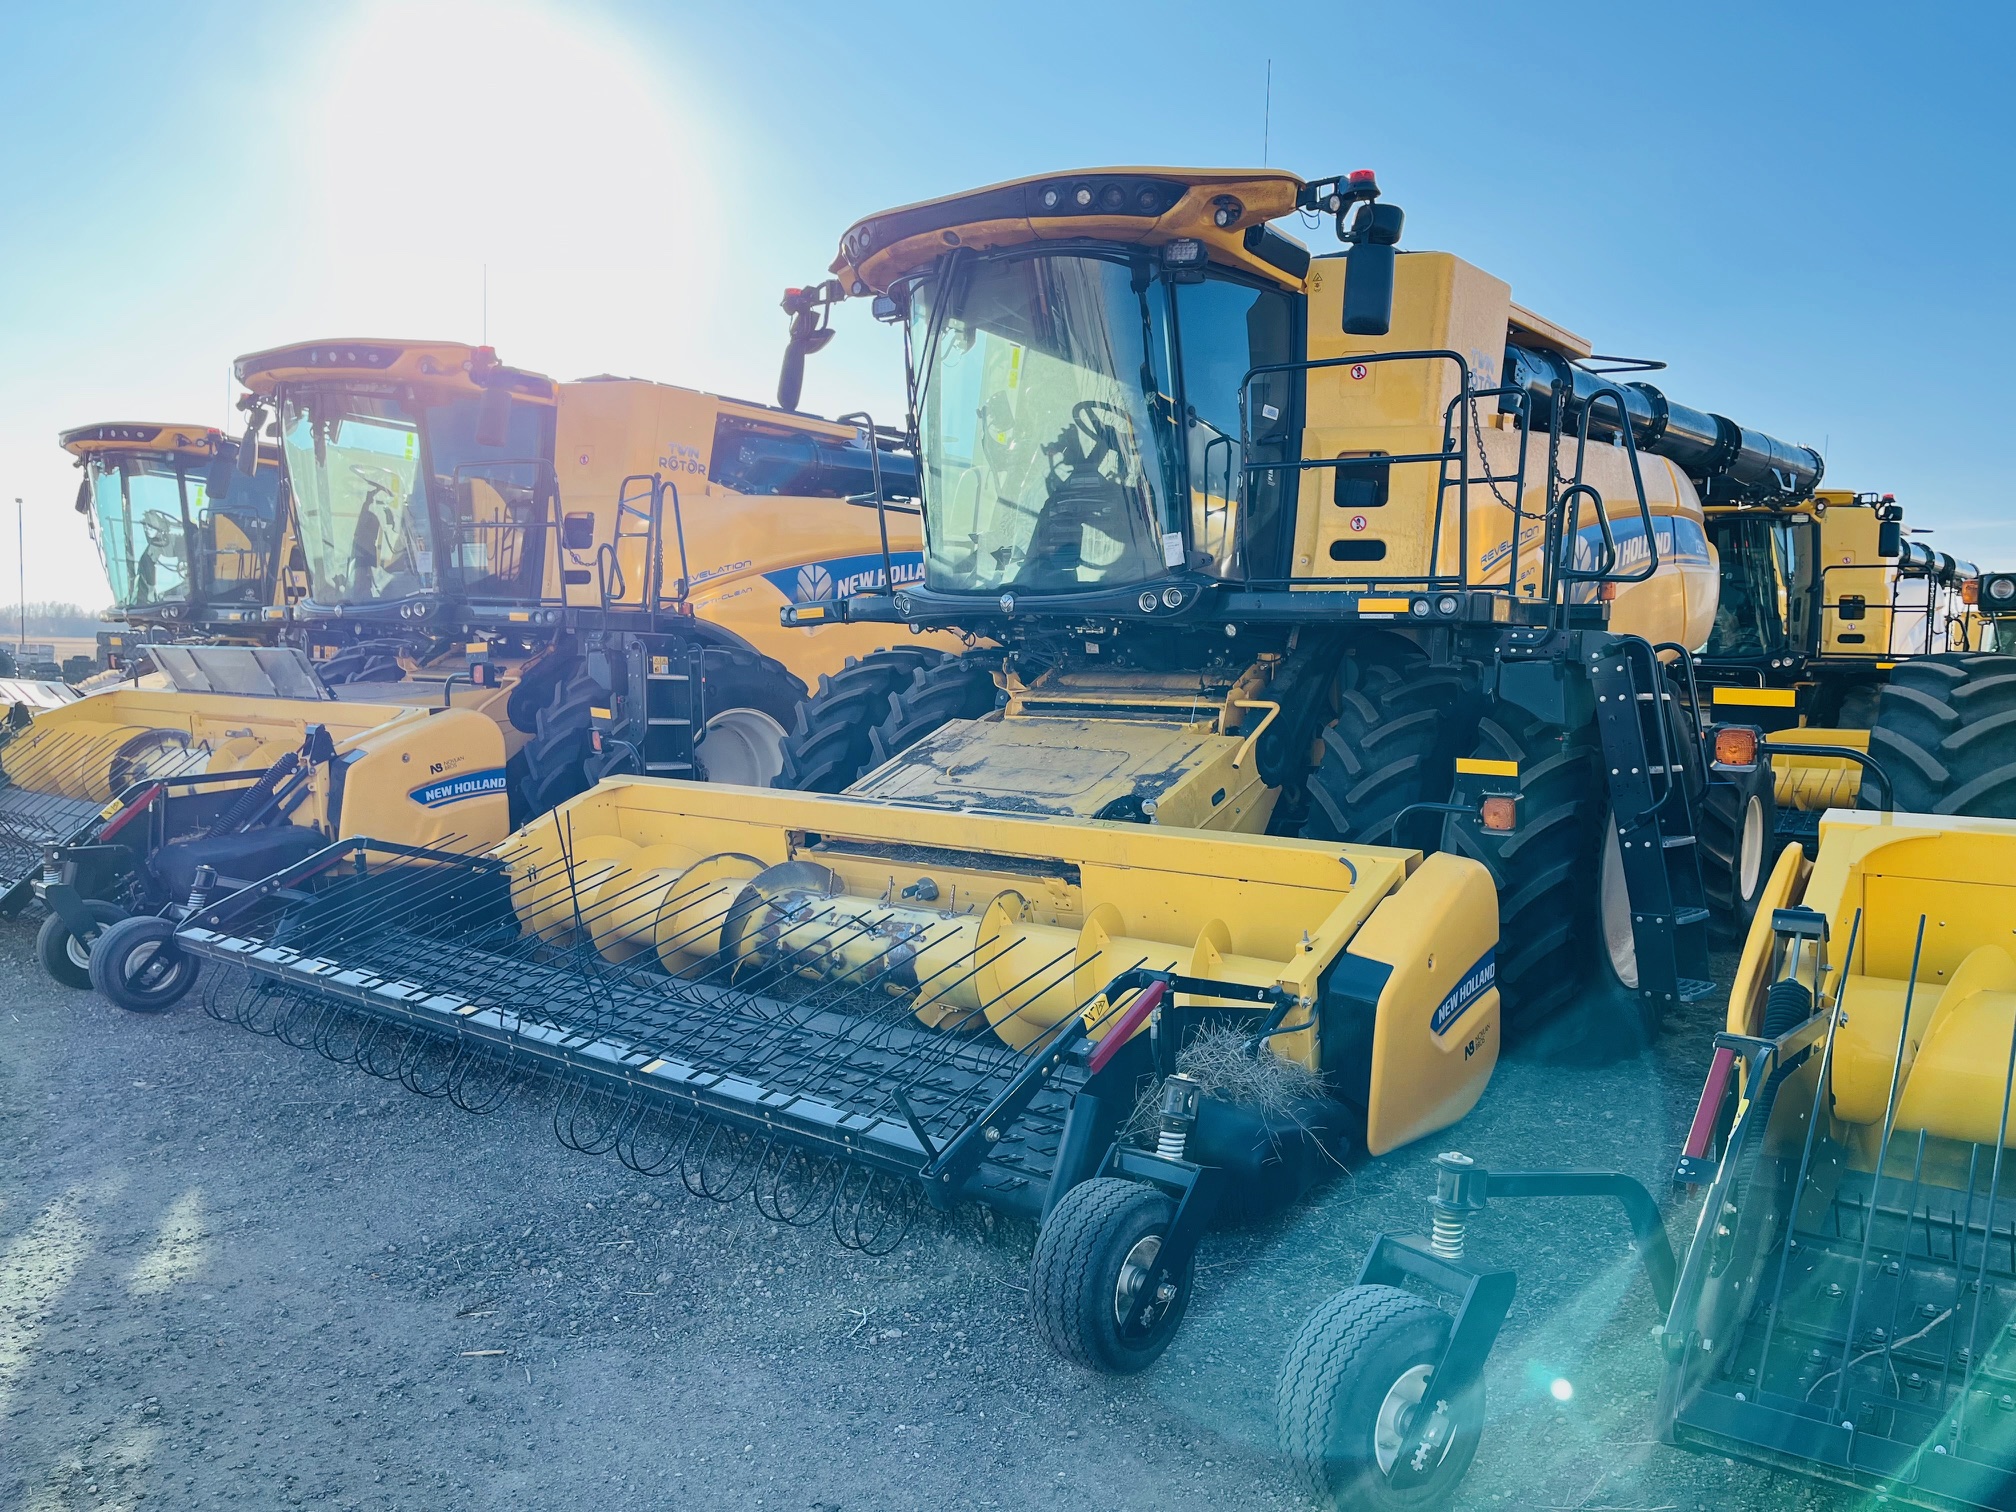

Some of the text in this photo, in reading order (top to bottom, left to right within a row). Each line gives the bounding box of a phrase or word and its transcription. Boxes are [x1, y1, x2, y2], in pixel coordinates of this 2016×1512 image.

[658, 455, 706, 475] ROTOR
[1480, 525, 1540, 567] REVELTION
[1622, 532, 1671, 566] HOLLND
[673, 560, 752, 591] VELATION
[837, 562, 926, 600] NEW HOLLA
[425, 777, 507, 802] NEW HOLLAND
[1438, 962, 1496, 1025] NEW HOLLAND
